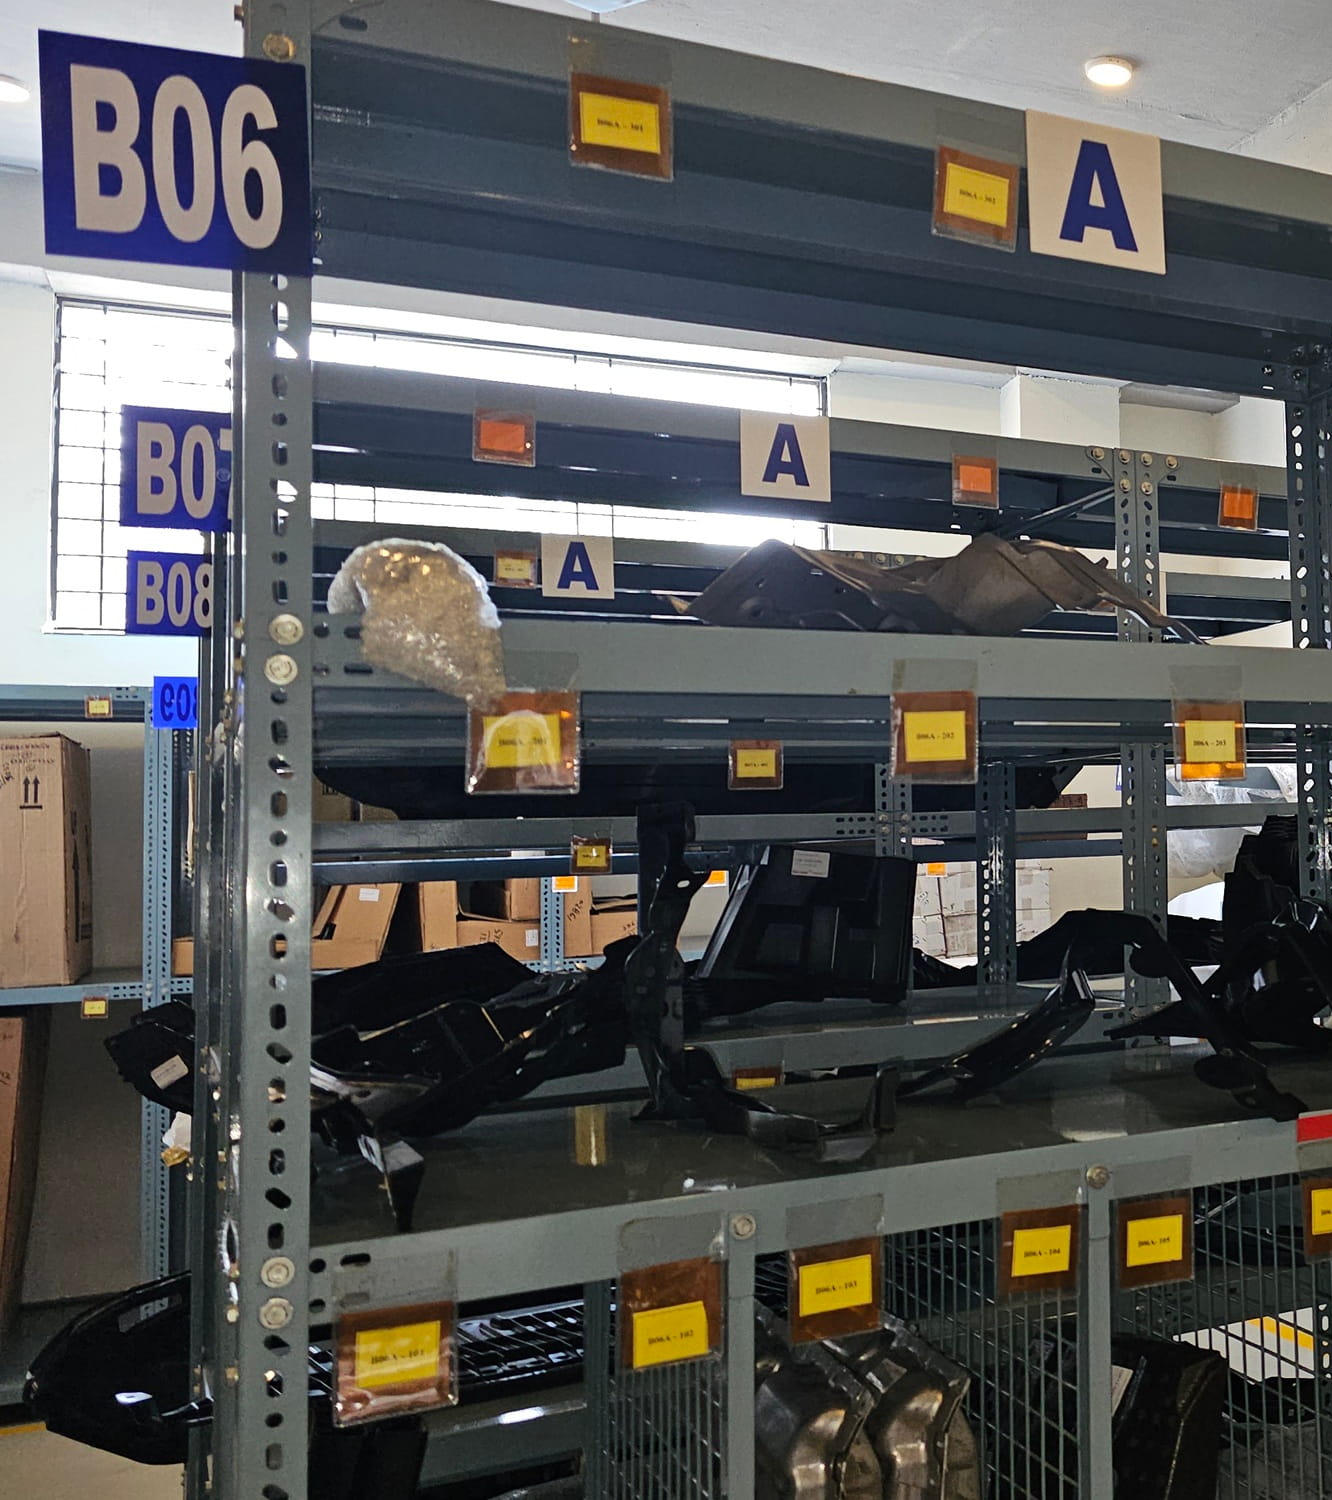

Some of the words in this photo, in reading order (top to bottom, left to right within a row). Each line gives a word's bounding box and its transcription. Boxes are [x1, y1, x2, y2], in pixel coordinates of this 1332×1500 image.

[70, 63, 284, 250] B06
[1059, 139, 1138, 252] A
[761, 423, 810, 487] A
[137, 560, 213, 628] B08
[557, 541, 599, 591] A
